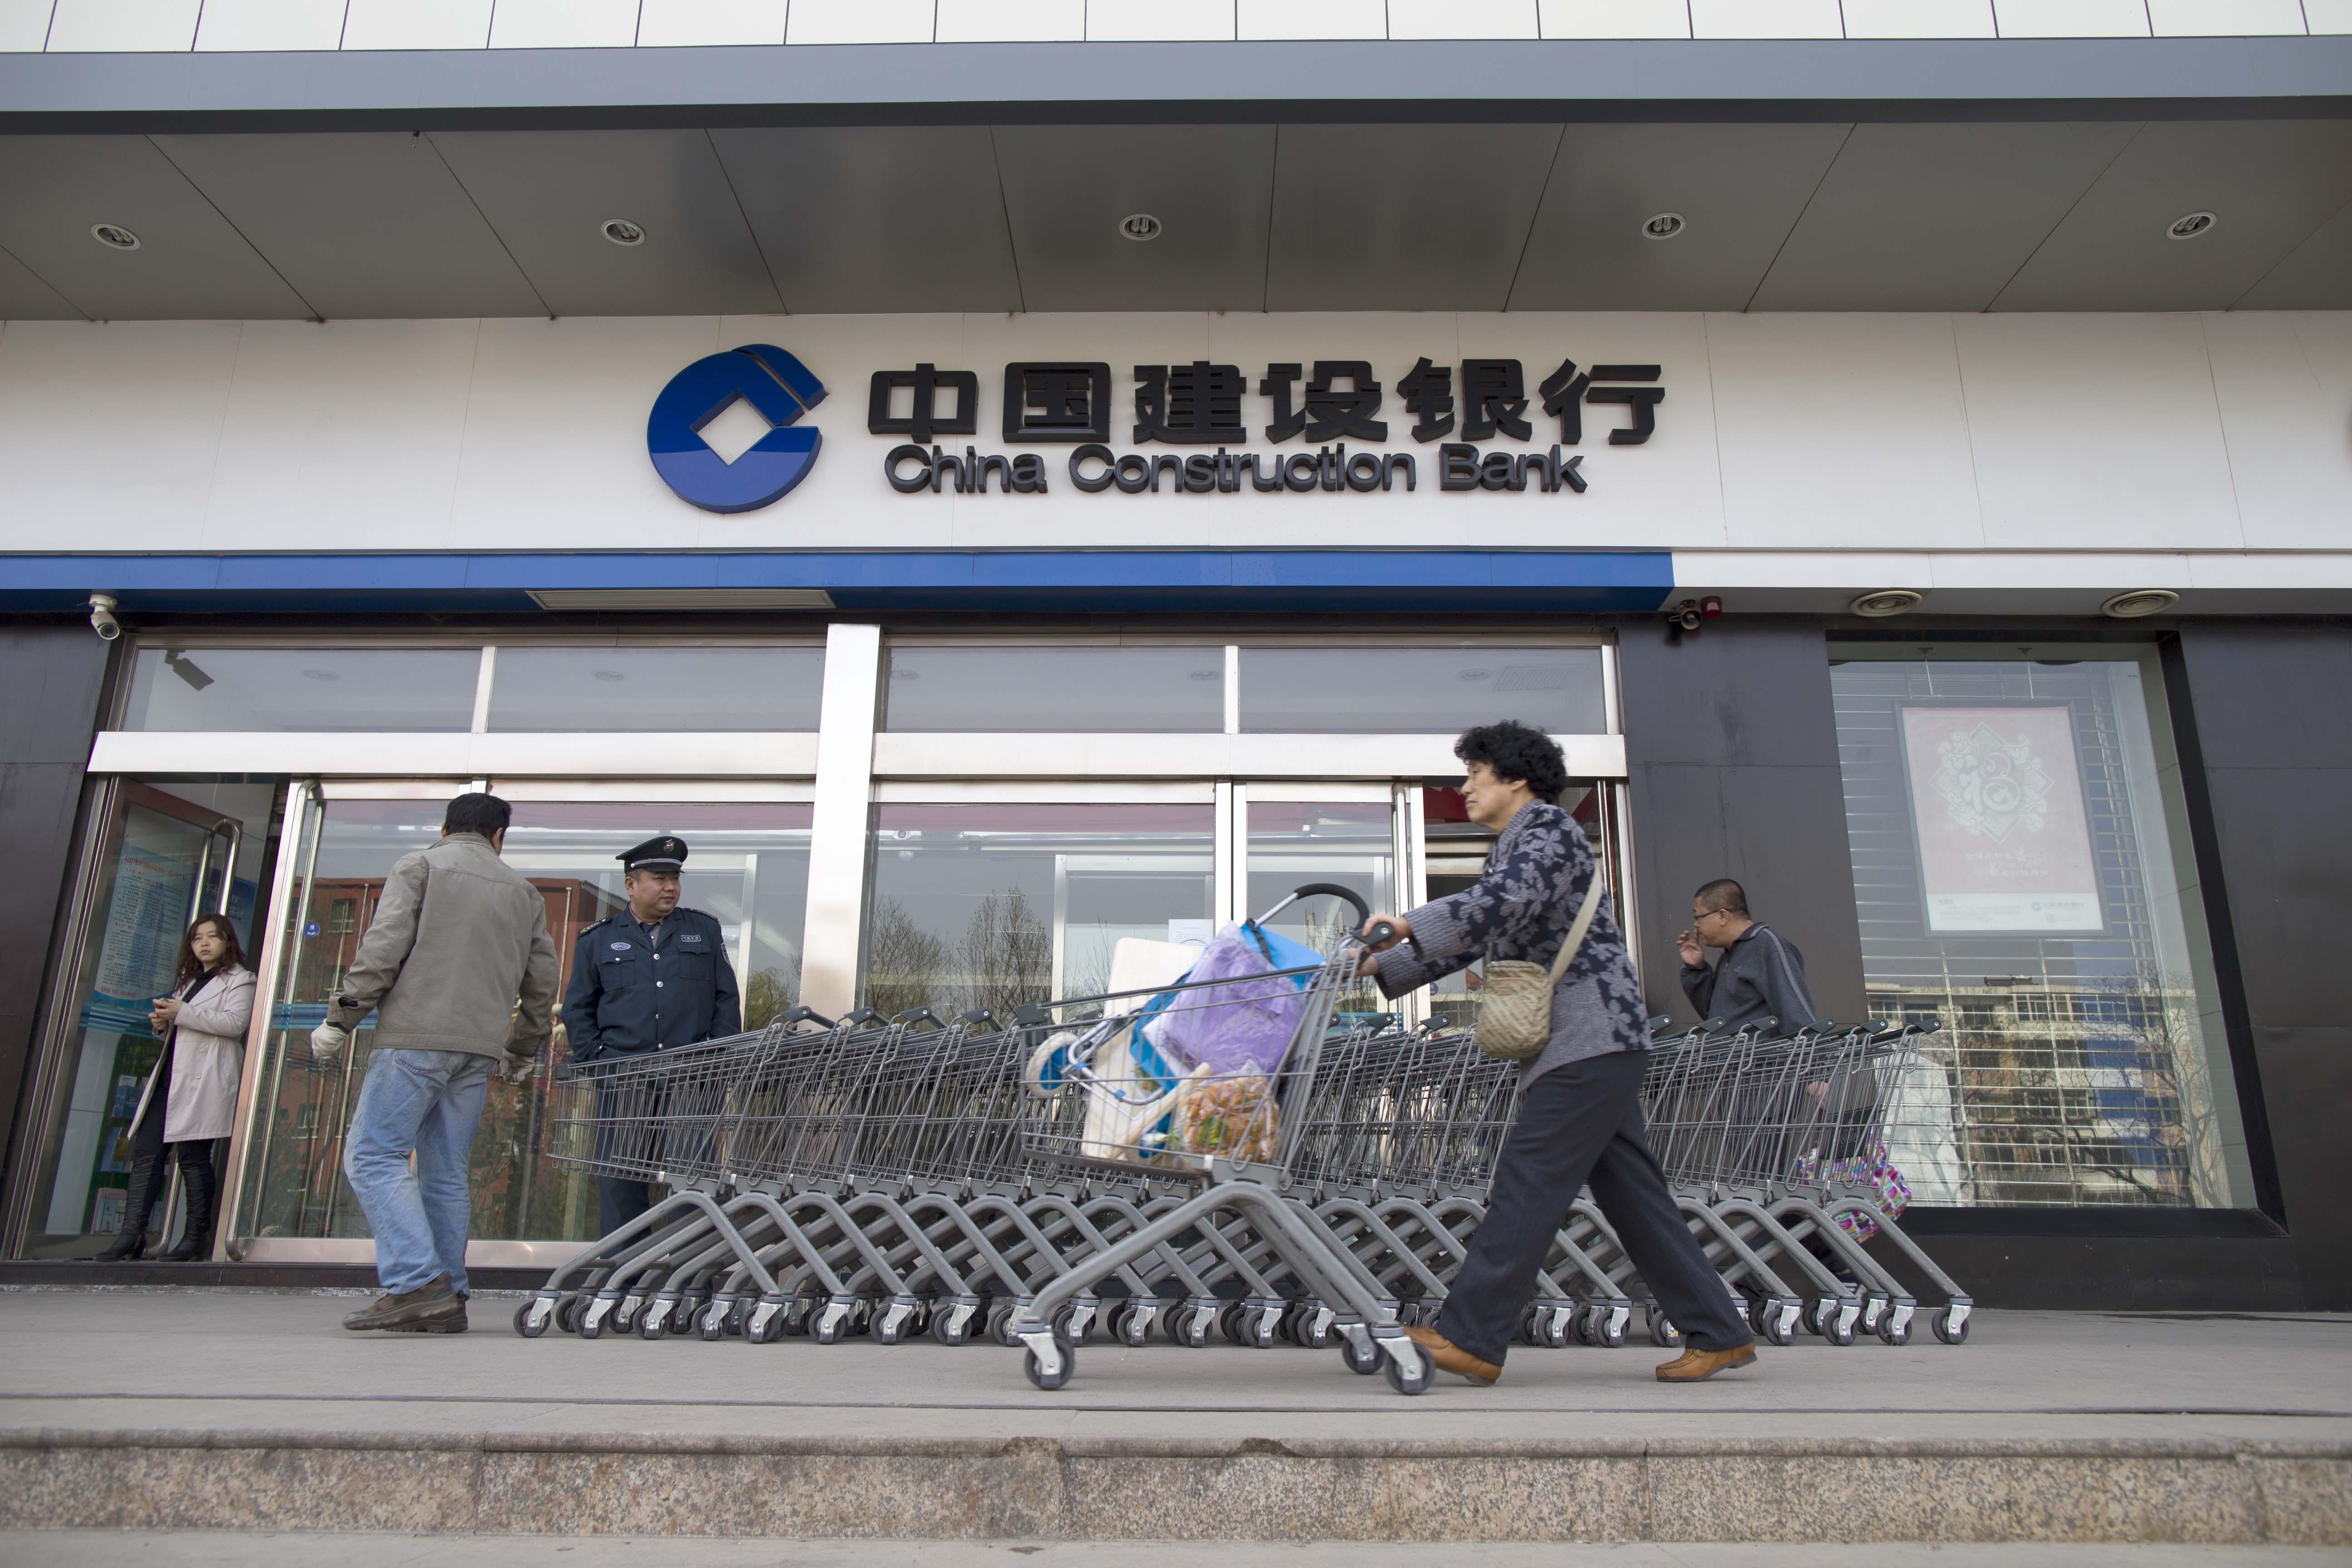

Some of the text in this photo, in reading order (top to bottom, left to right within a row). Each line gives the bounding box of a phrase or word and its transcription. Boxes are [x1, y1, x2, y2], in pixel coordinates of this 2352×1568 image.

[868, 357, 1665, 445] 中国建设银行
[884, 443, 1588, 494] China Construction Bank
